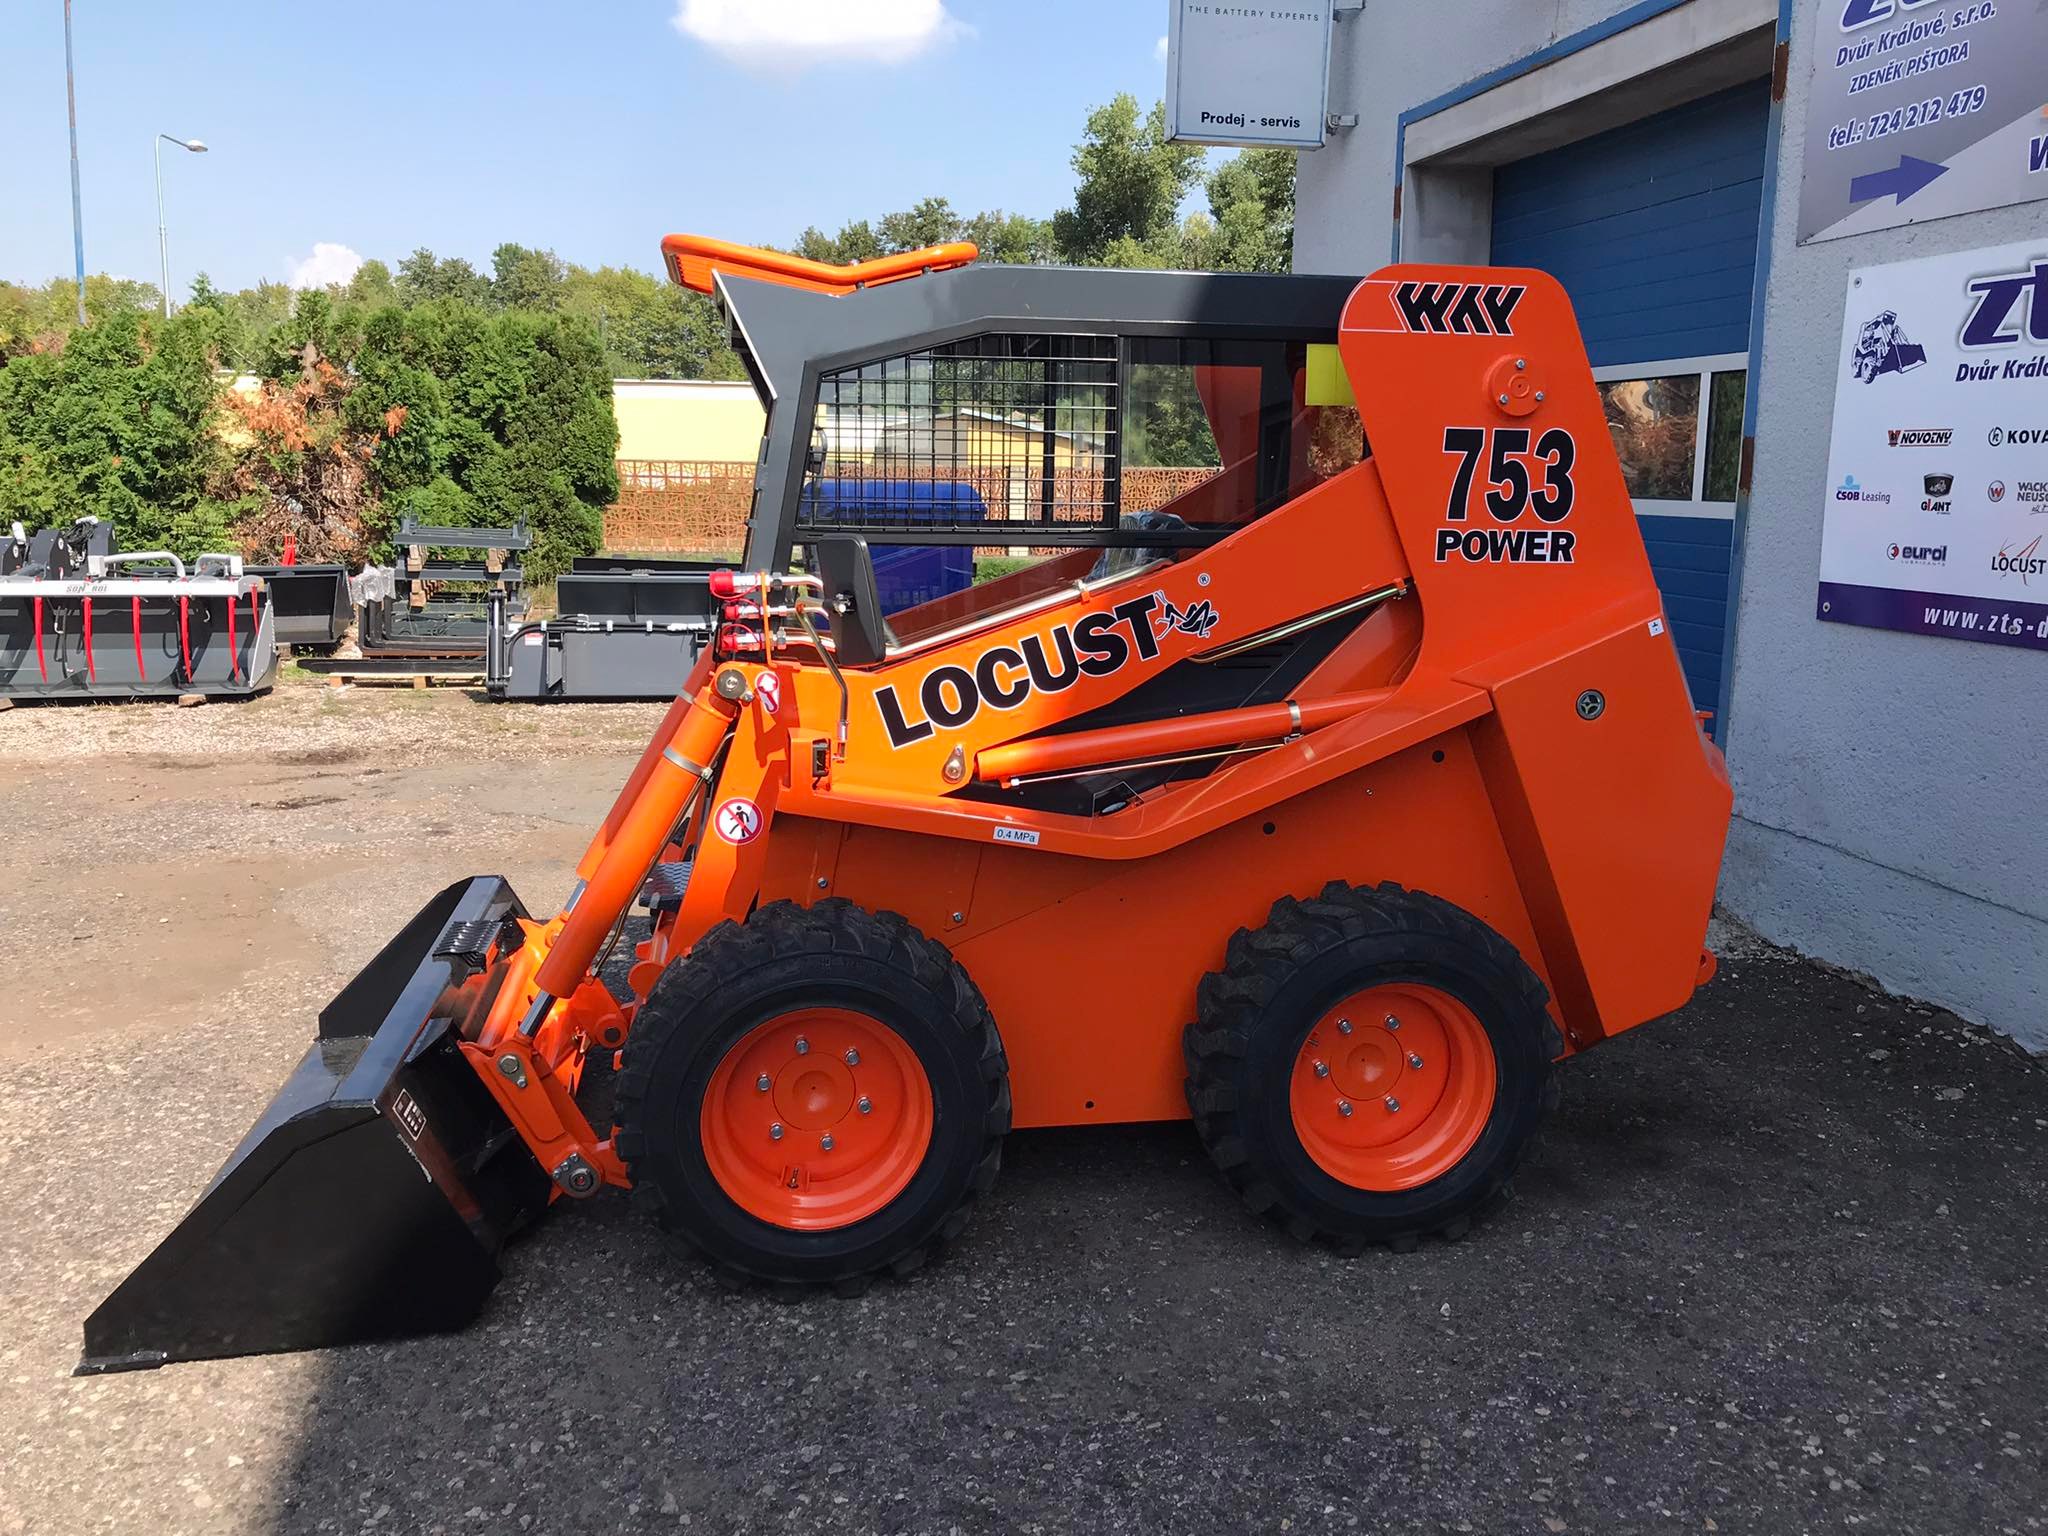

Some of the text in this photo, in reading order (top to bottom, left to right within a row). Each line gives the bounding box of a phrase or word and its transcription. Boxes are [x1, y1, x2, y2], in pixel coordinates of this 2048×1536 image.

[1189, 5, 1319, 22] THE BATTERY EXPERTS
[1836, 37, 1874, 67] Dvůr
[1878, 11, 1948, 54] Králové,
[1952, 1, 1997, 29] s.r.o.
[1849, 41, 1970, 94] ZDENĚK PIŠTORA
[1201, 111, 1245, 128] Prodej
[1260, 116, 1301, 129] servis
[1828, 84, 1986, 150] tel.: 724 212 479
[1392, 281, 1527, 335] WAY
[1955, 358, 2000, 382] Dvůr
[1441, 427, 1576, 523] 753
[1861, 491, 1891, 504] Leasing
[1434, 528, 1577, 563] POWER
[1902, 545, 1948, 562] eurol
[1991, 555, 2047, 575] LOCUST
[873, 592, 1161, 750] LOCUST
[997, 828, 1036, 843] 0.4 MPa
